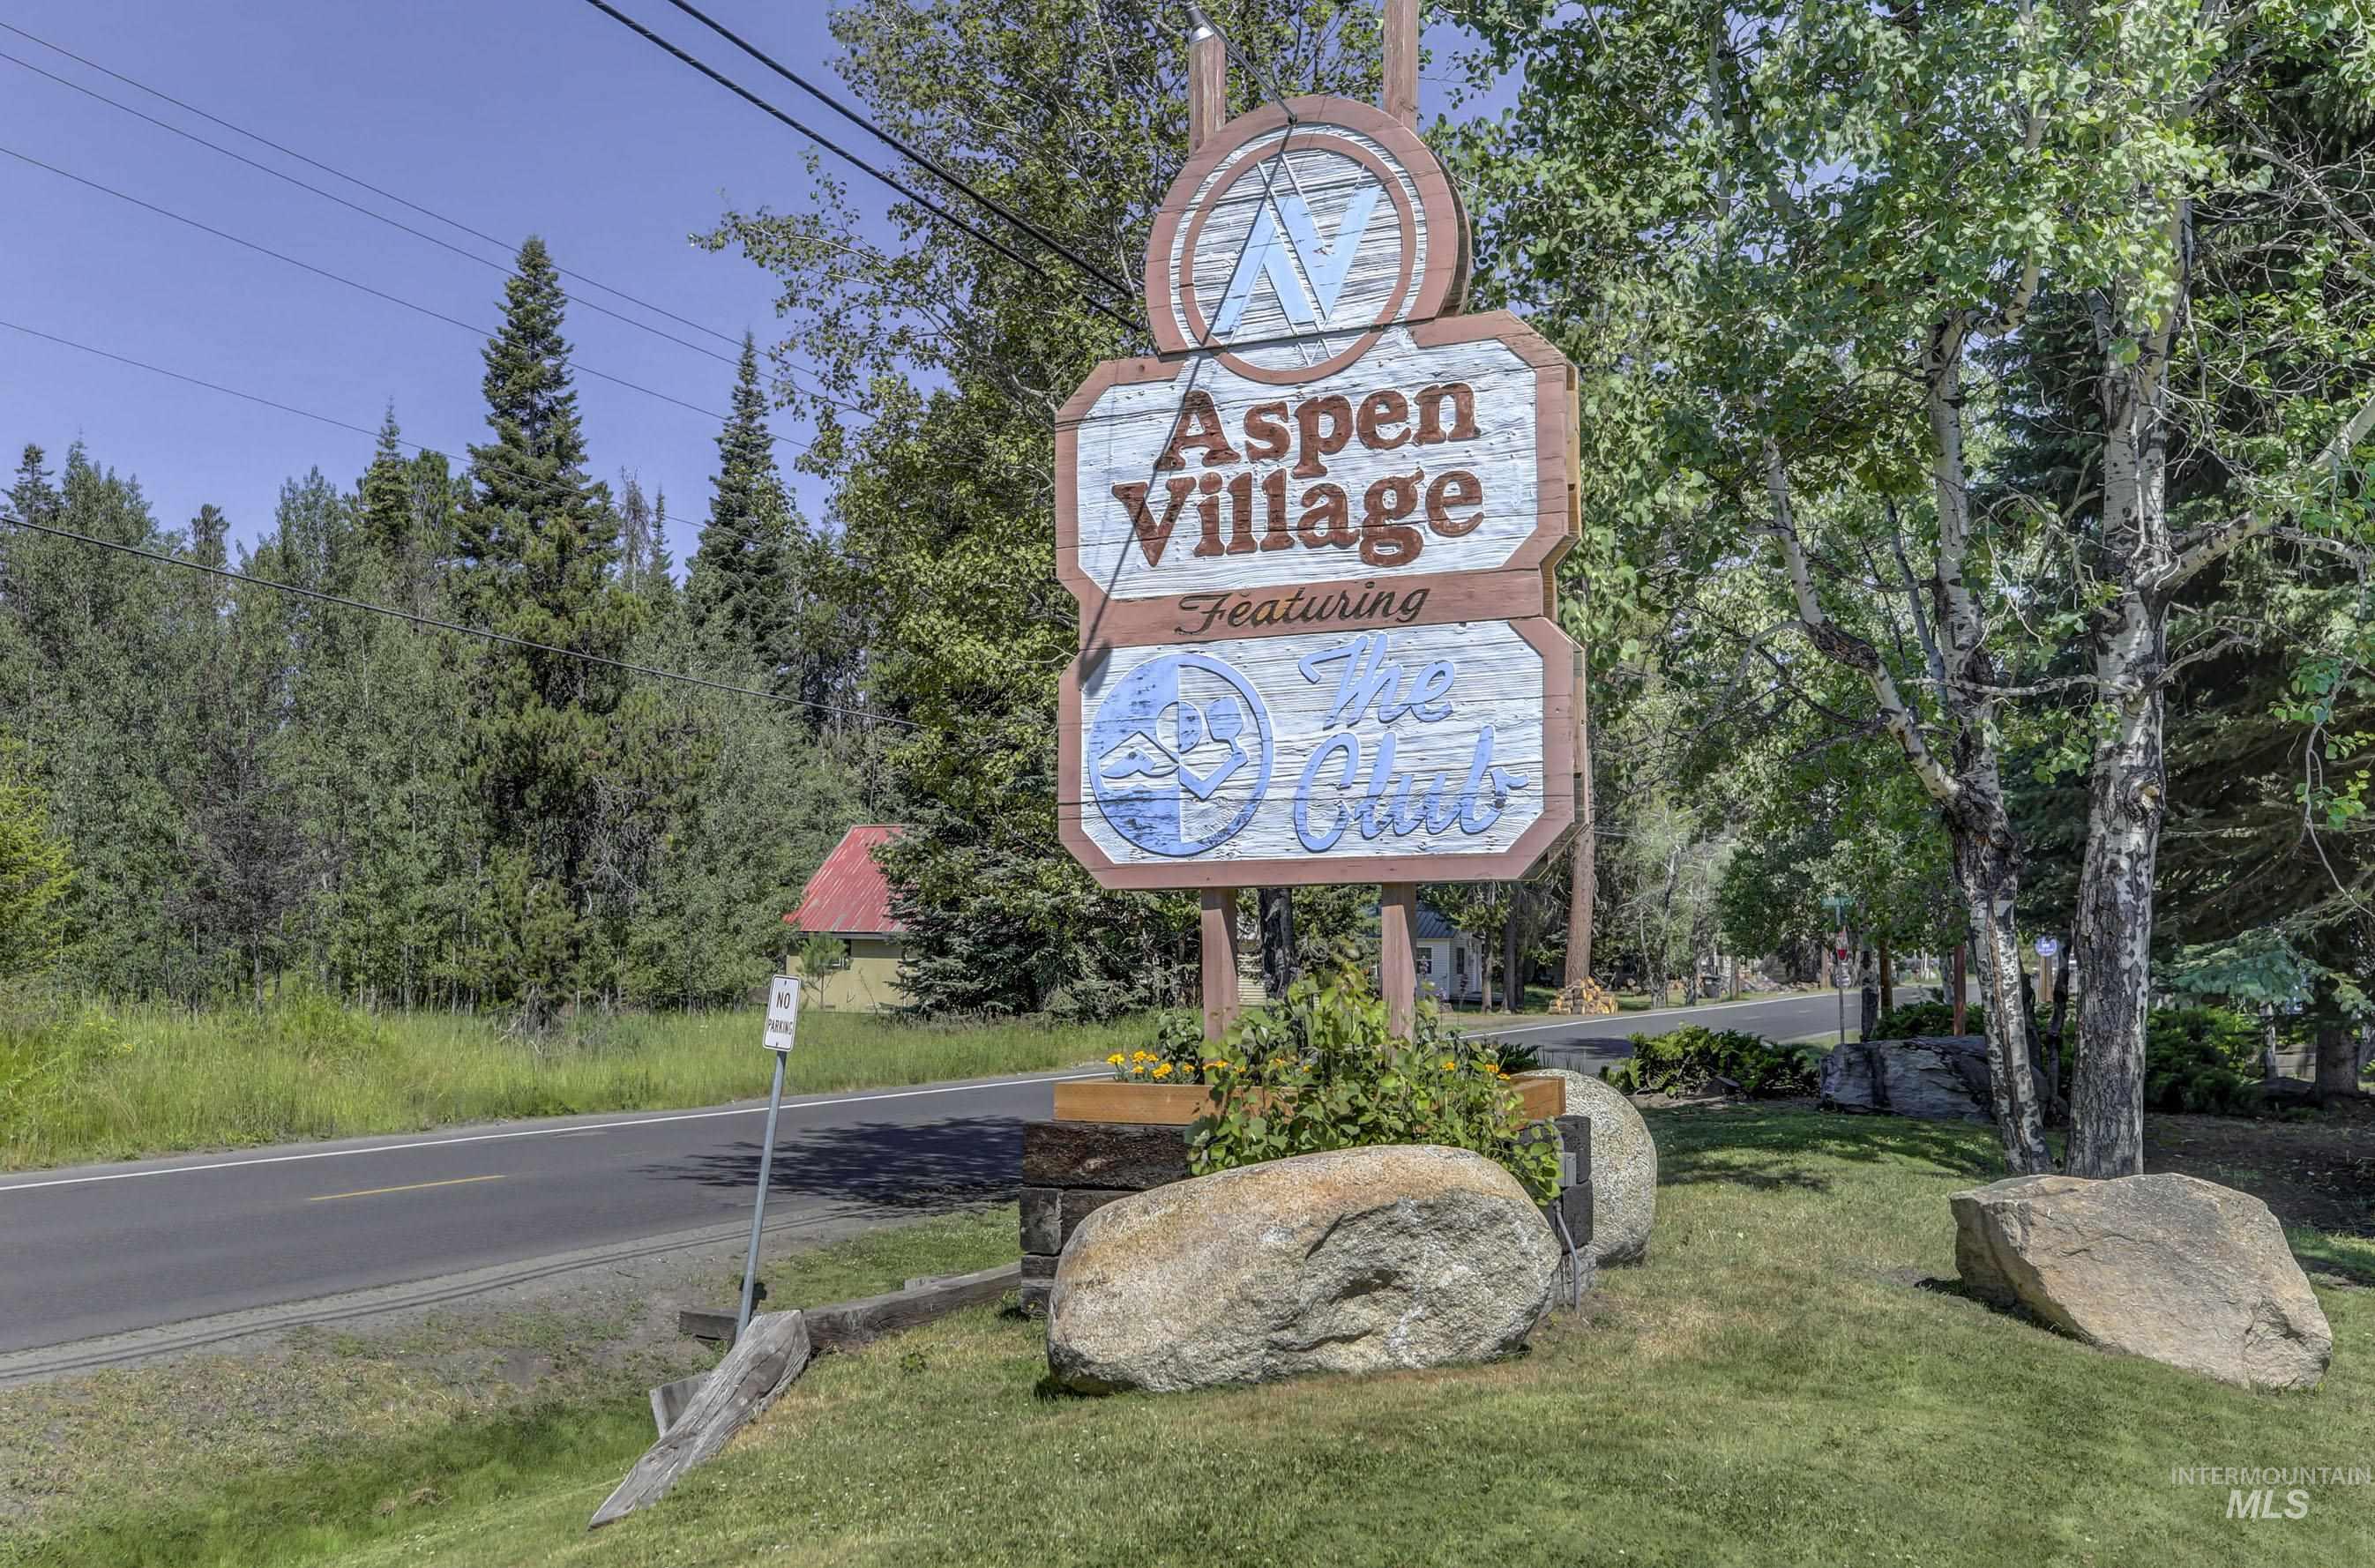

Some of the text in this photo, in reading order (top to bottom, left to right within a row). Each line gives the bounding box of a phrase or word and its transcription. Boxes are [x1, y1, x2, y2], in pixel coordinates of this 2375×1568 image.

[1154, 382, 1482, 479] Aspen
[1111, 467, 1484, 567] Village
[1175, 580, 1430, 636] Featuring
[1297, 631, 1456, 730] The
[1293, 725, 1529, 853] Club
[768, 1018, 794, 1036] PARKING
[776, 991, 791, 1010] NO
